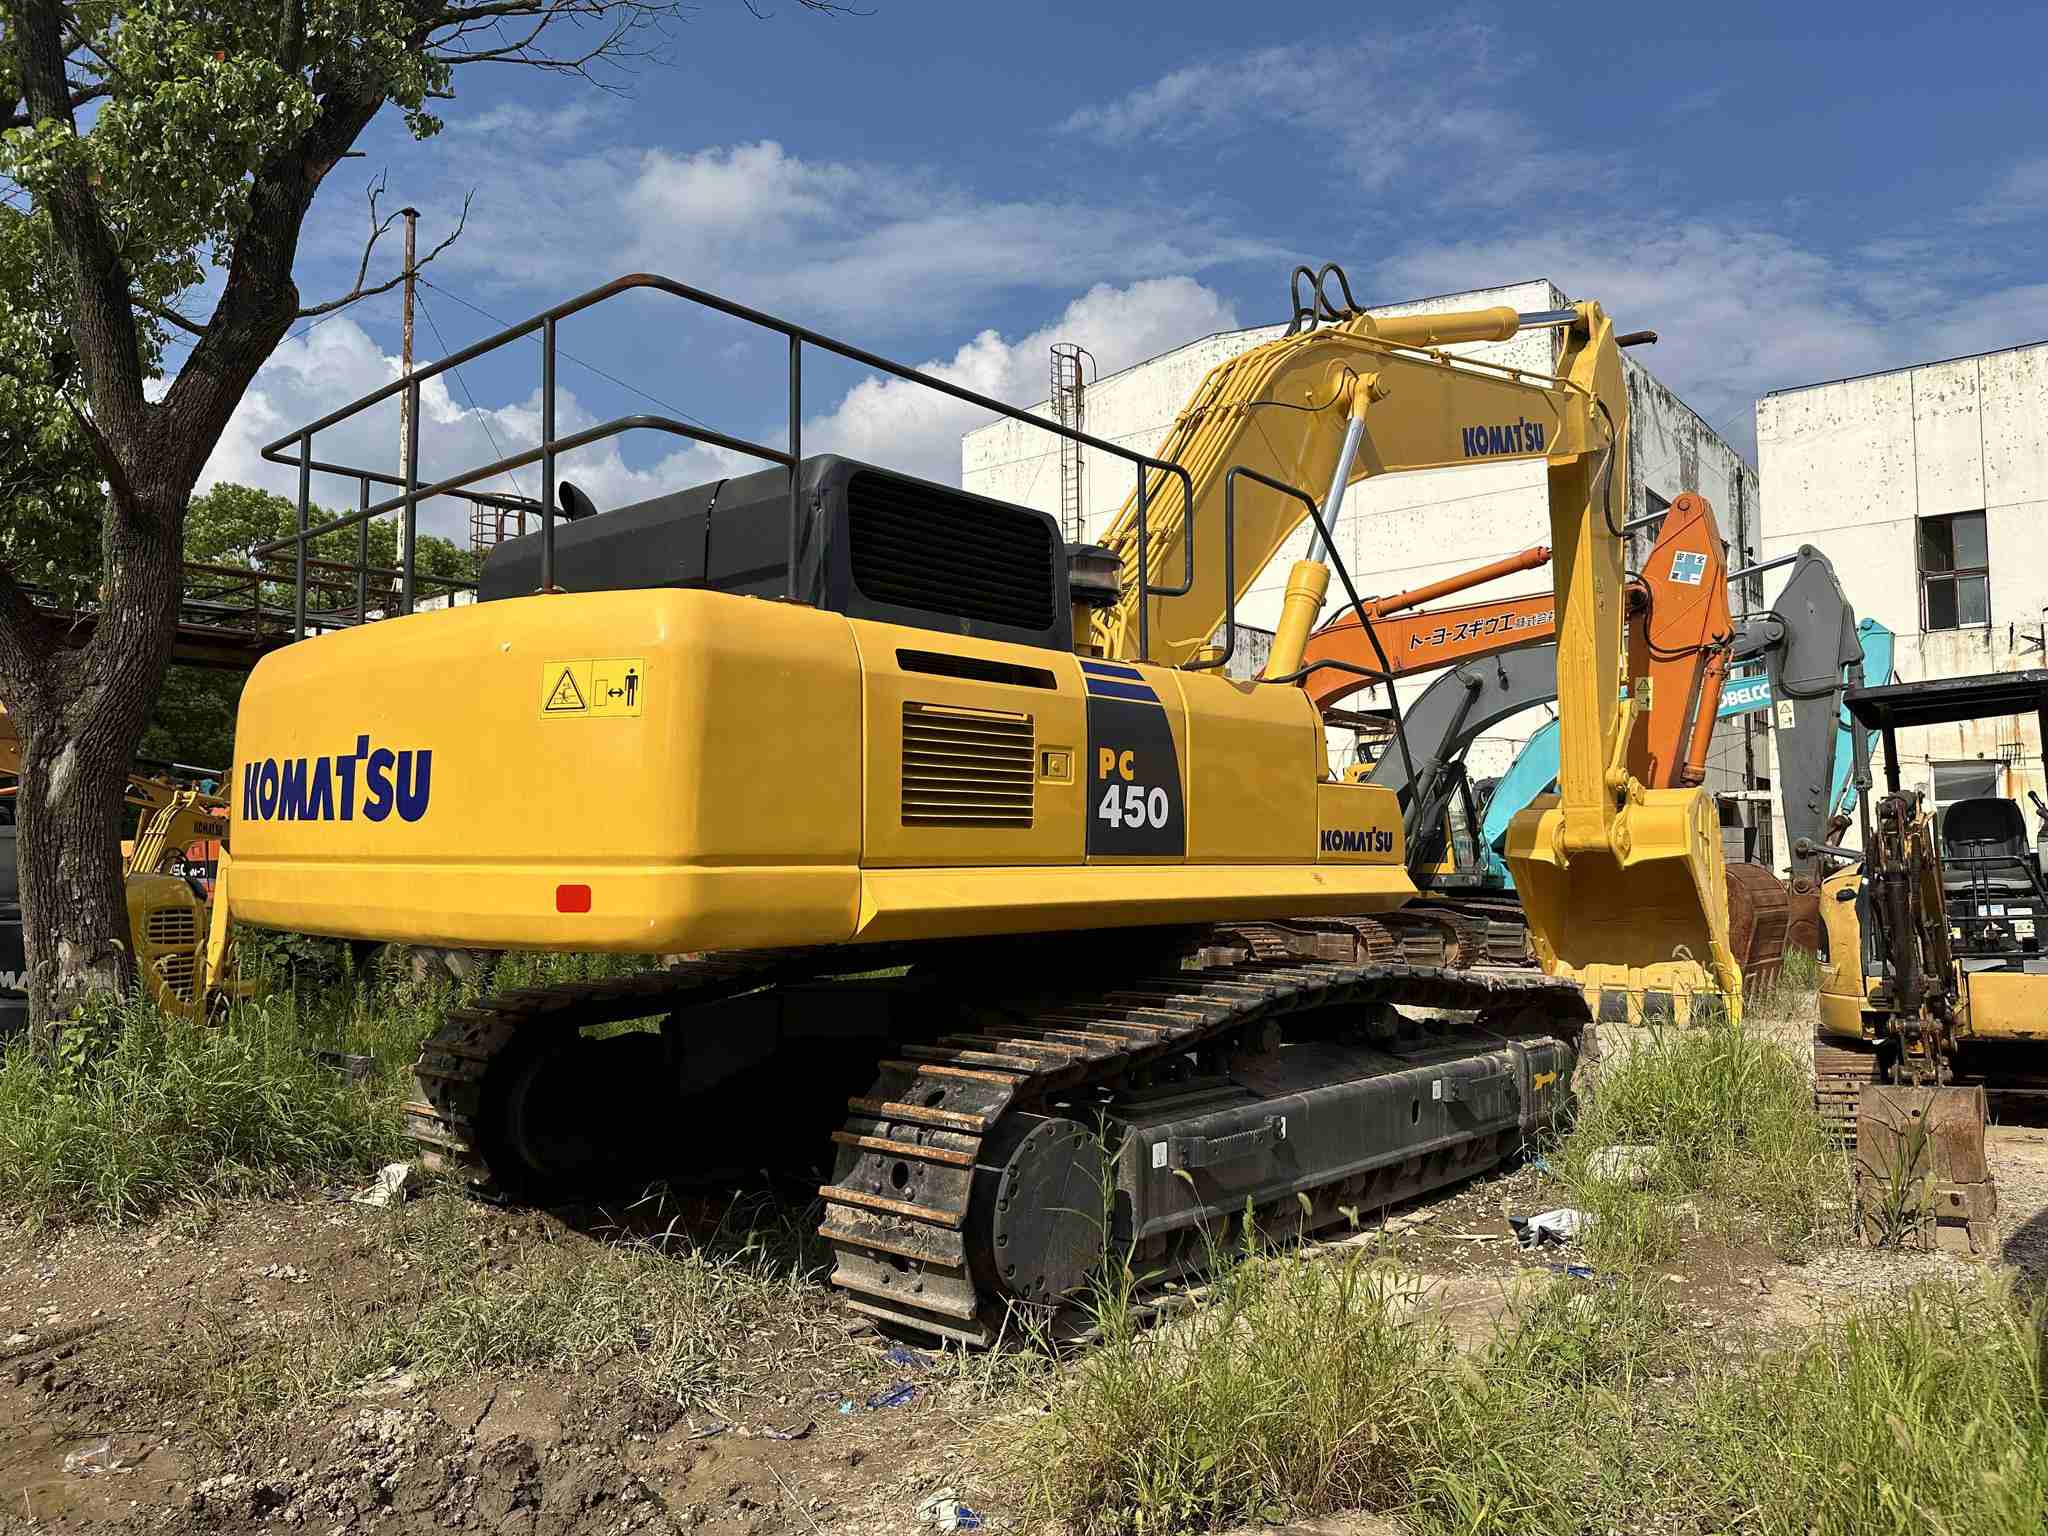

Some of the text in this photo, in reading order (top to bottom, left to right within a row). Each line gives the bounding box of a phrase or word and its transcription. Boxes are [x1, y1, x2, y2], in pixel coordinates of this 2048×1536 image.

[1462, 416, 1545, 457] KOMATSU
[243, 734, 432, 822] KOMATSU
[1099, 747, 1135, 781] PC
[1099, 784, 1169, 829] 450
[1320, 826, 1393, 852] KOMATSU
